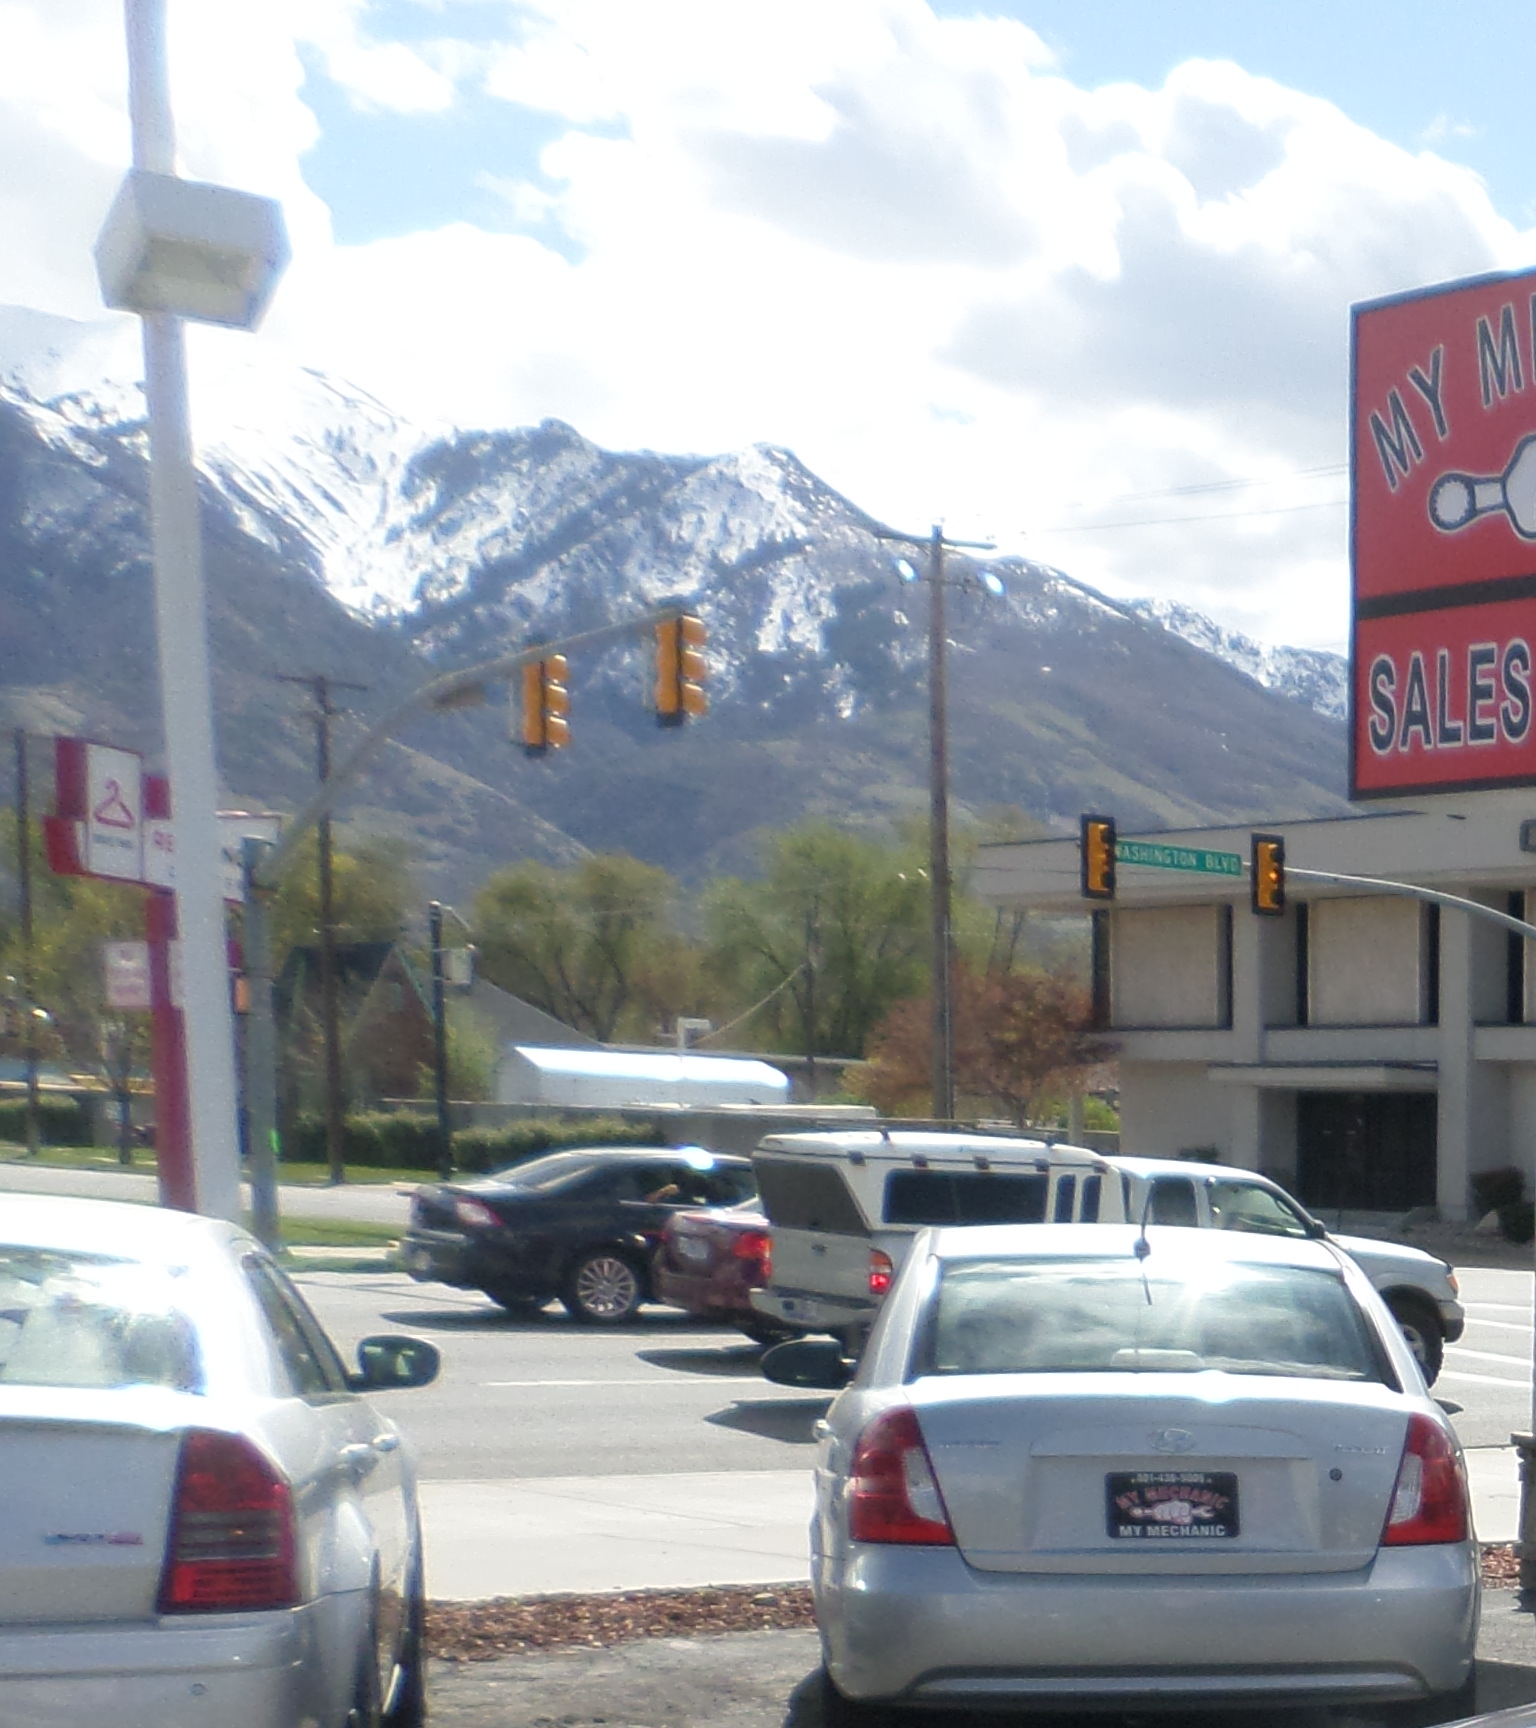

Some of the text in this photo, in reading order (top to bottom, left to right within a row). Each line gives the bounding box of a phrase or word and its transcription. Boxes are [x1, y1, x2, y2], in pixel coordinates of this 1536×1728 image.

[1368, 343, 1449, 492] MY
[1367, 637, 1532, 756] SALES
[1119, 1525, 1226, 1537] MY MECHANIC
[1143, 1485, 1230, 1510] MECHANIC
